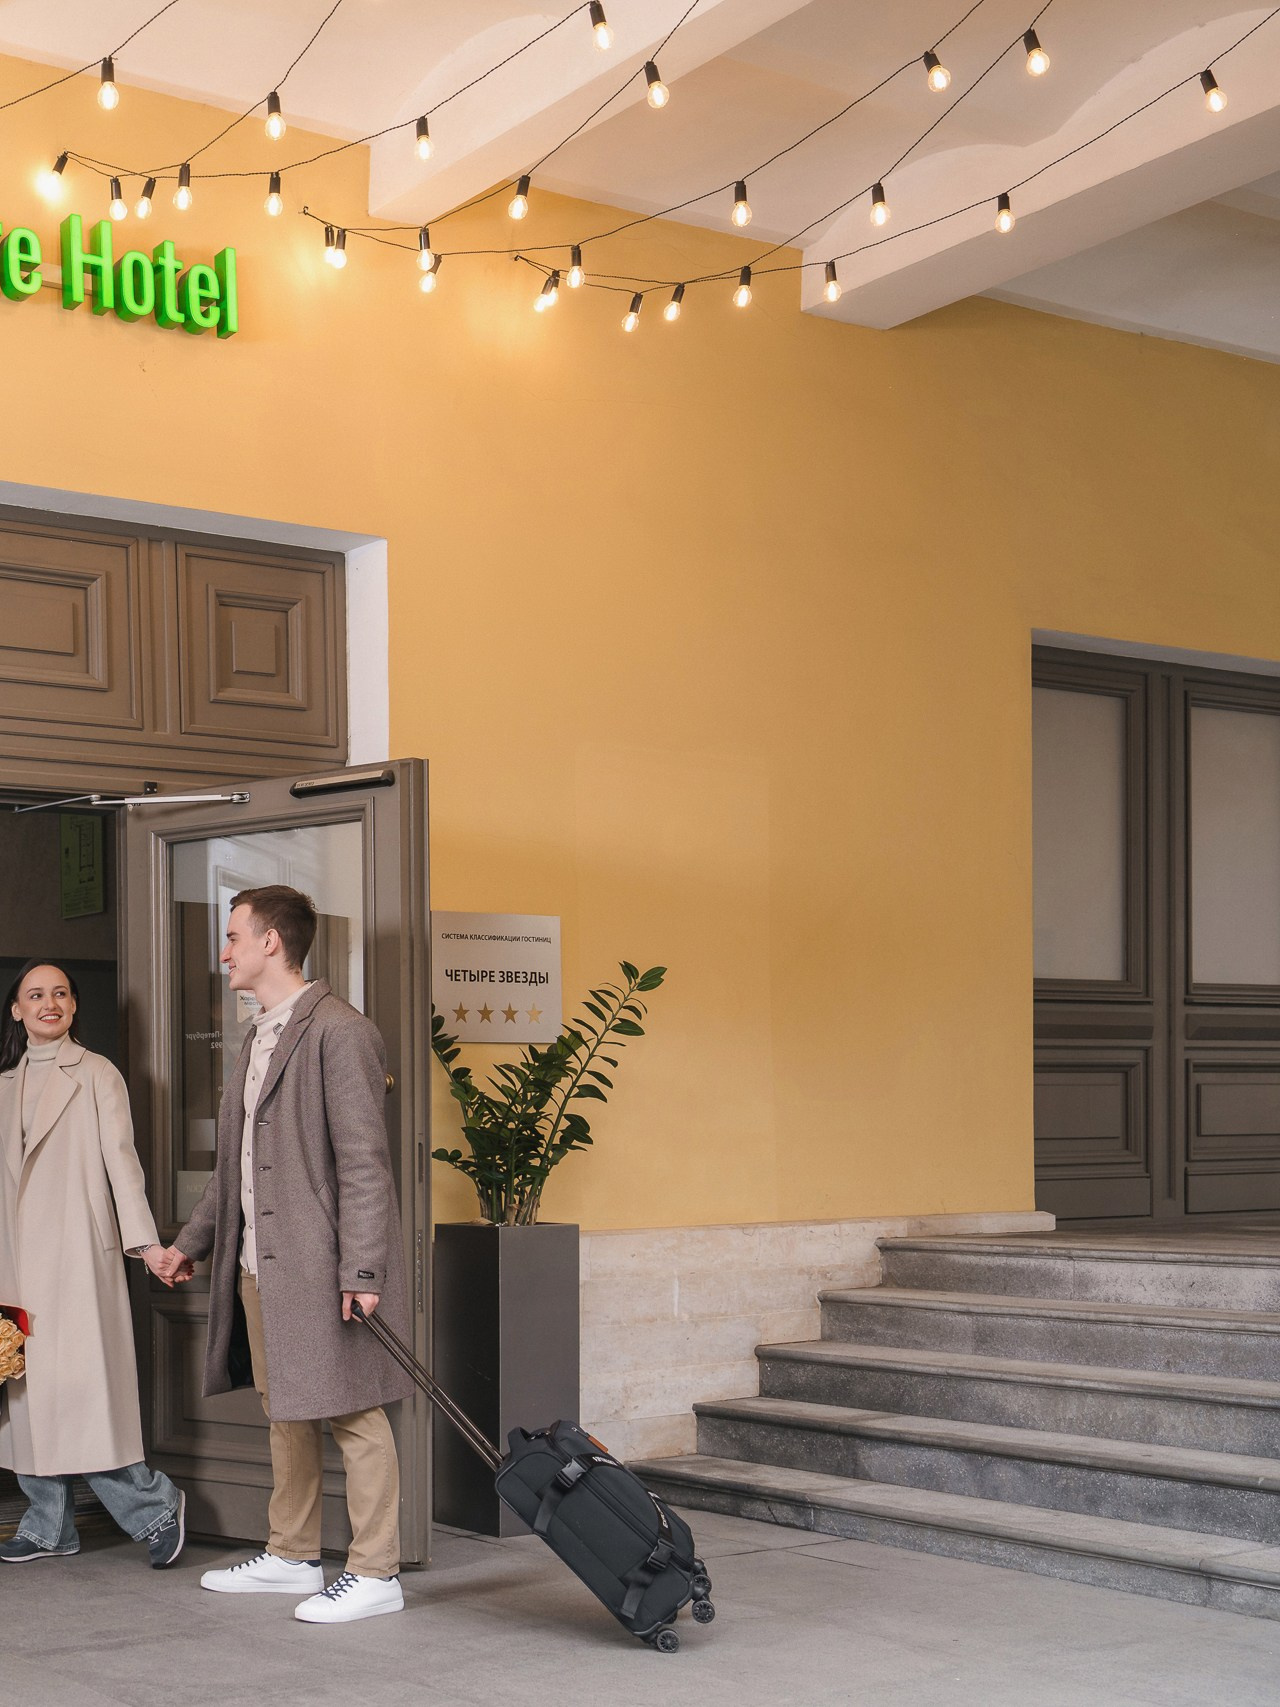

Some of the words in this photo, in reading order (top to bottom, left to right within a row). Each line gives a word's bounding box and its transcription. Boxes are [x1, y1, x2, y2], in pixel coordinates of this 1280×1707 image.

[60, 213, 239, 339] Hotel
[441, 932, 469, 940] СИСТЕМА
[469, 933, 521, 943] КЛАССИФИКАЦИИ
[521, 935, 552, 944] ГОСТИНИЦ
[445, 968, 495, 983] ЧЕТЫРЕ
[498, 970, 549, 986] ЗВЕЗДЫ
